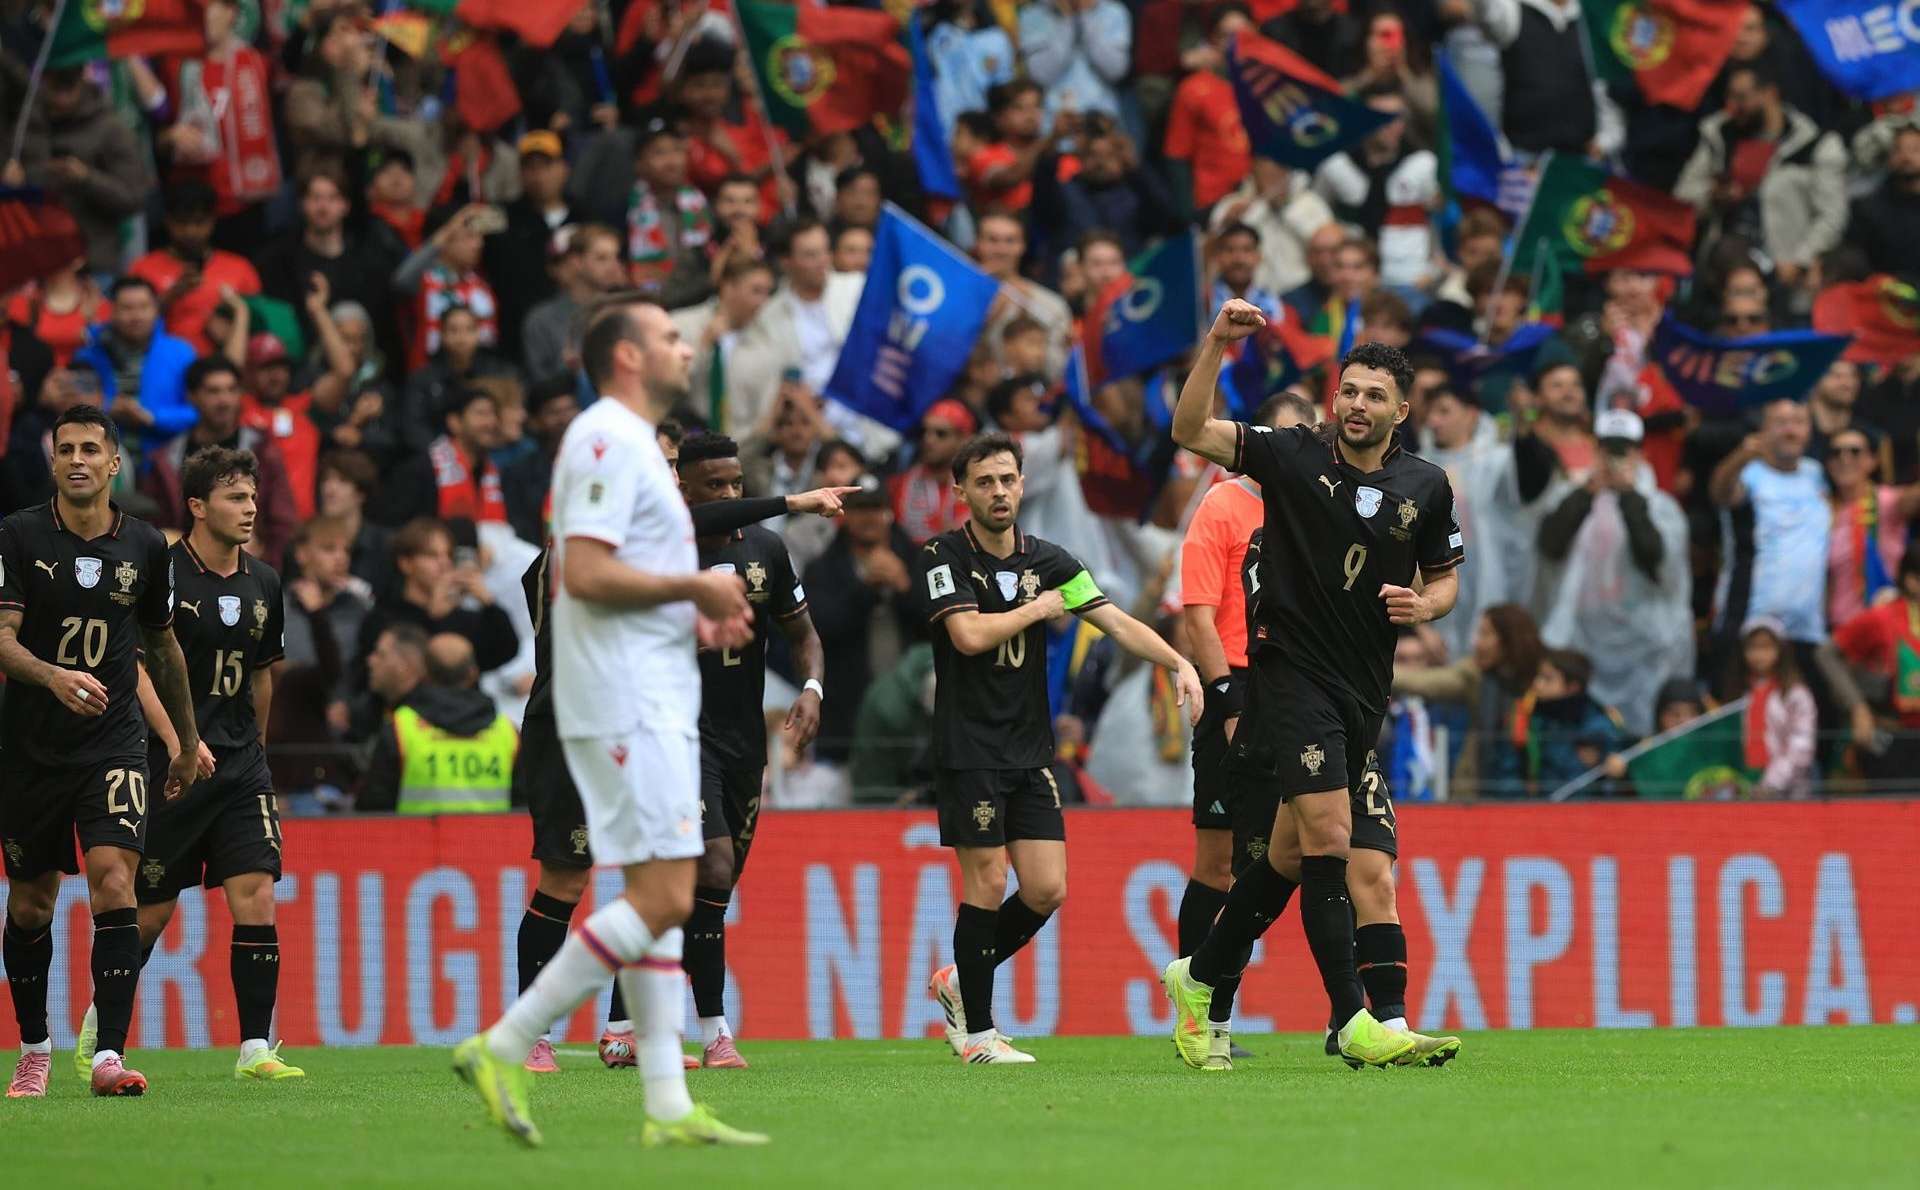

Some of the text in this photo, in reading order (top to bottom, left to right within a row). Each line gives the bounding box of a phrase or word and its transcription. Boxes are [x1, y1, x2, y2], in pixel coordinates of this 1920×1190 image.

[1343, 543, 1367, 591] 9
[57, 616, 108, 668] 20
[995, 628, 1025, 669] 10
[210, 649, 243, 697] 15
[426, 752, 500, 779] 1104
[105, 768, 146, 816] 20
[1363, 771, 1396, 819] 2
[1125, 858, 1276, 1037] S
[1390, 851, 1919, 1032] XPLICA.
